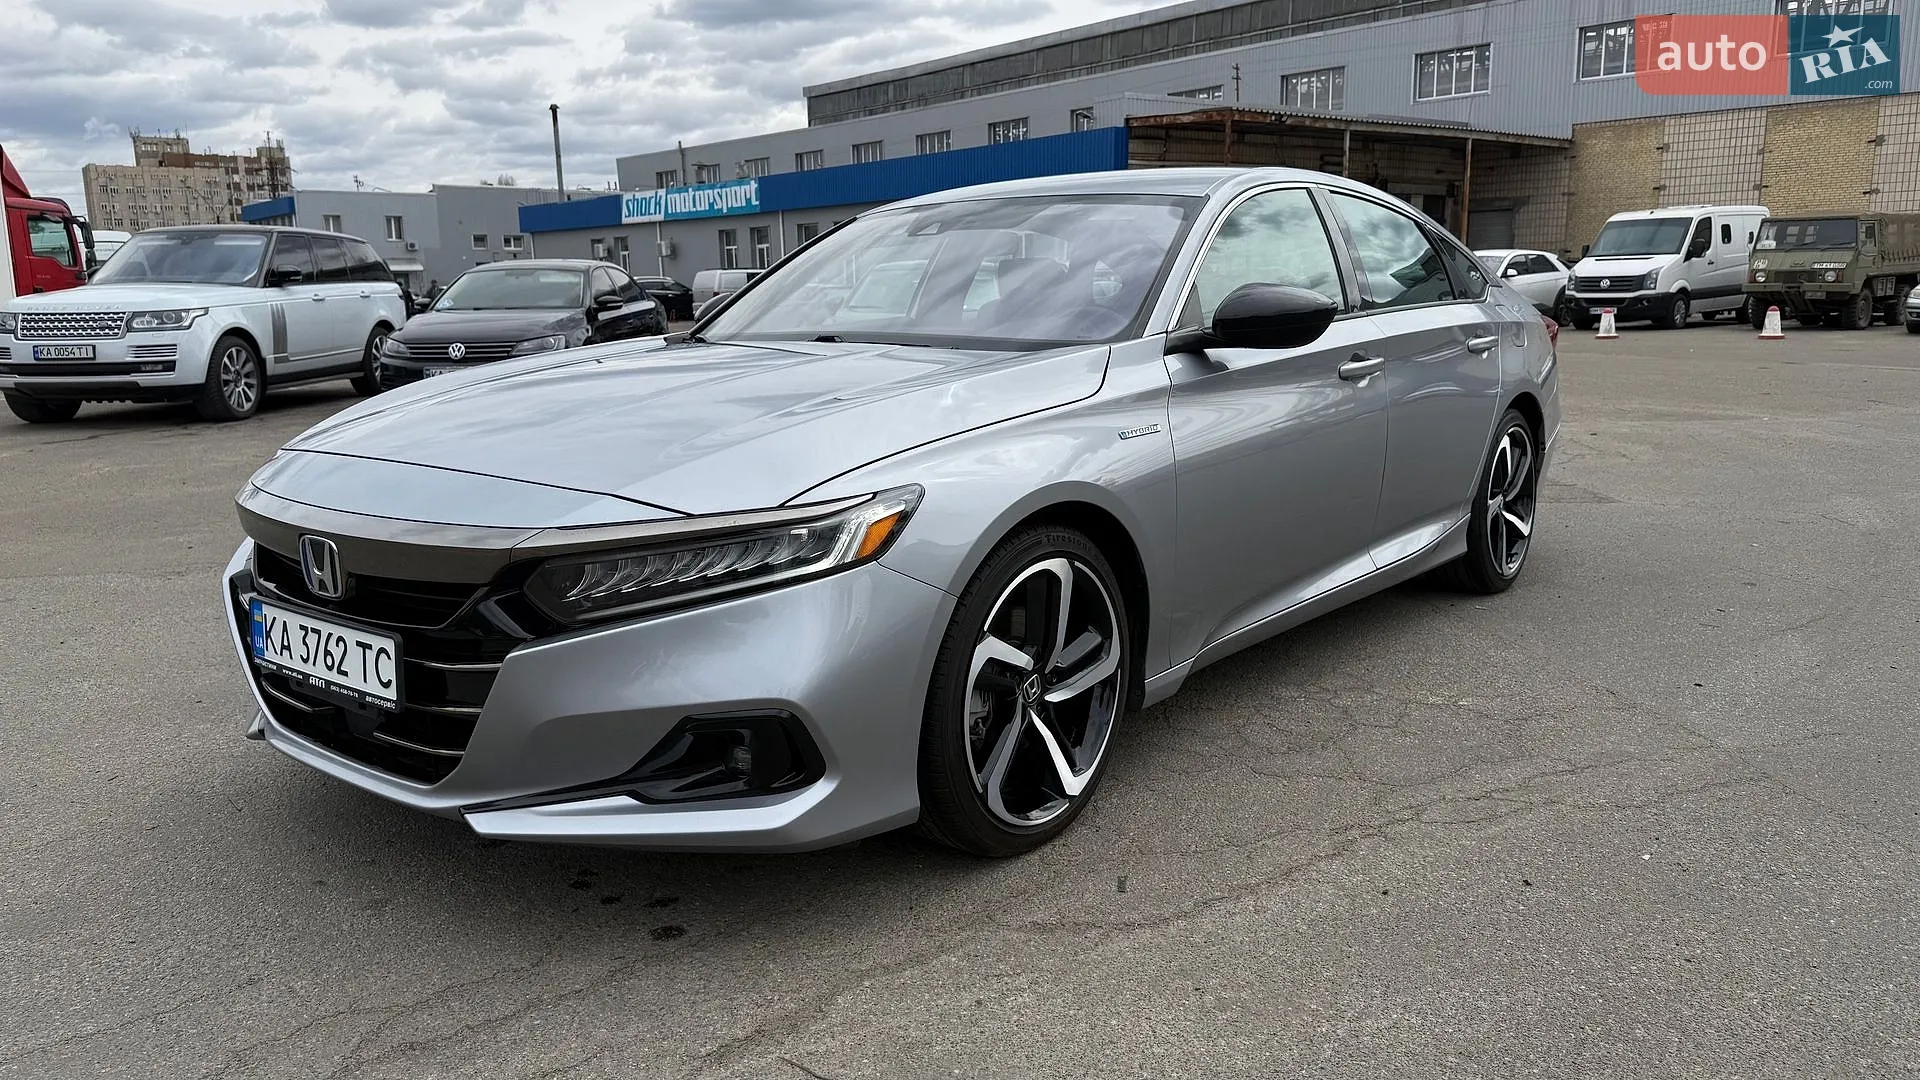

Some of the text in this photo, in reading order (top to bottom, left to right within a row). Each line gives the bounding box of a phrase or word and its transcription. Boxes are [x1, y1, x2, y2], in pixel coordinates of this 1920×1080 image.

[624, 179, 760, 218] shock motorsport
[39, 347, 52, 357] KA
[53, 347, 76, 357] 0054
[255, 637, 264, 649] UA
[264, 613, 393, 690] KA 3762 TC
